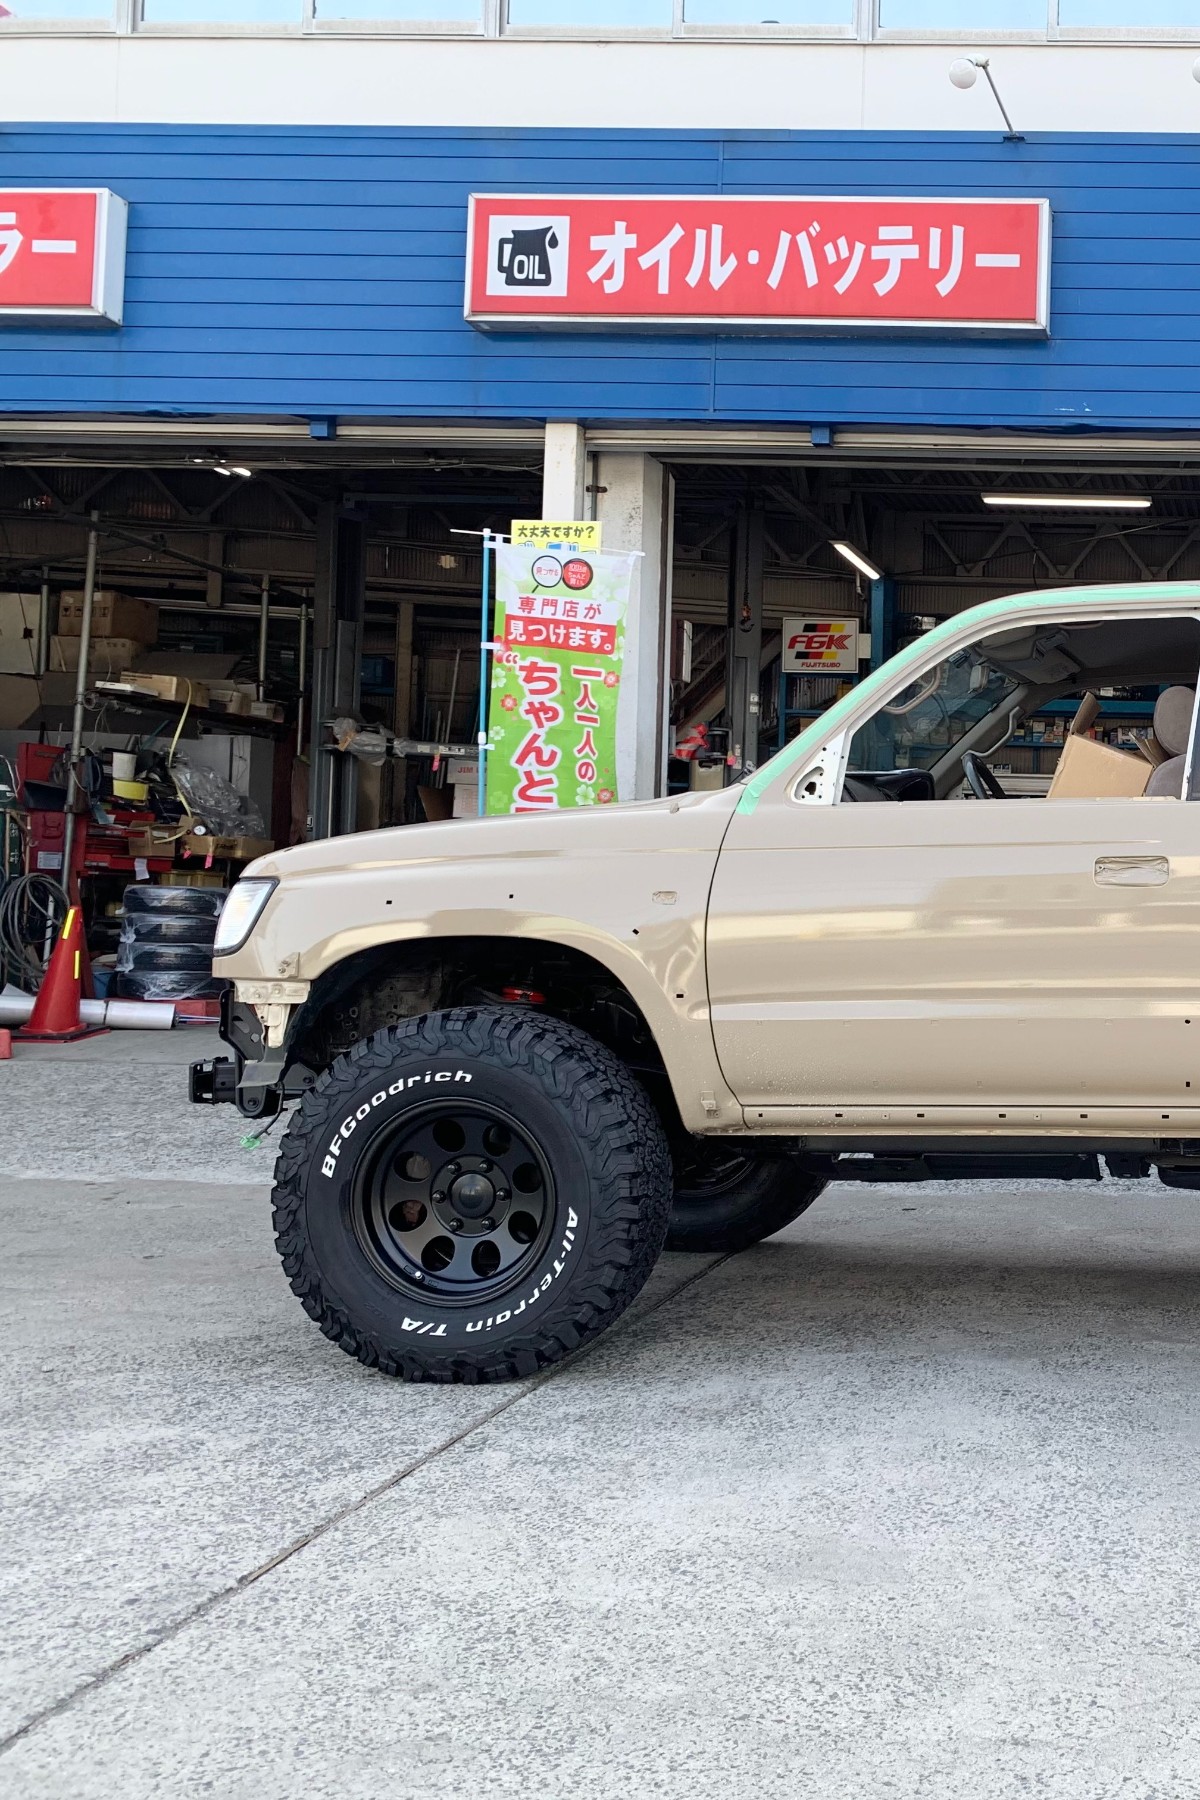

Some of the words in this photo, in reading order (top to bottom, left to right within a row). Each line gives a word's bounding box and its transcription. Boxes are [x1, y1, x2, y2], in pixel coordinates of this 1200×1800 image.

[512, 253, 546, 281] OIL
[586, 220, 1021, 298] オイル・バッテリー
[516, 524, 596, 540] 大丈夫ですか？
[517, 596, 602, 620] 専門店が
[507, 619, 613, 651] 見つけます。
[787, 634, 853, 650] FGK
[572, 667, 603, 781] 一人一人の
[321, 1069, 474, 1179] BFGoodrich
[400, 1316, 448, 1338] T/A
